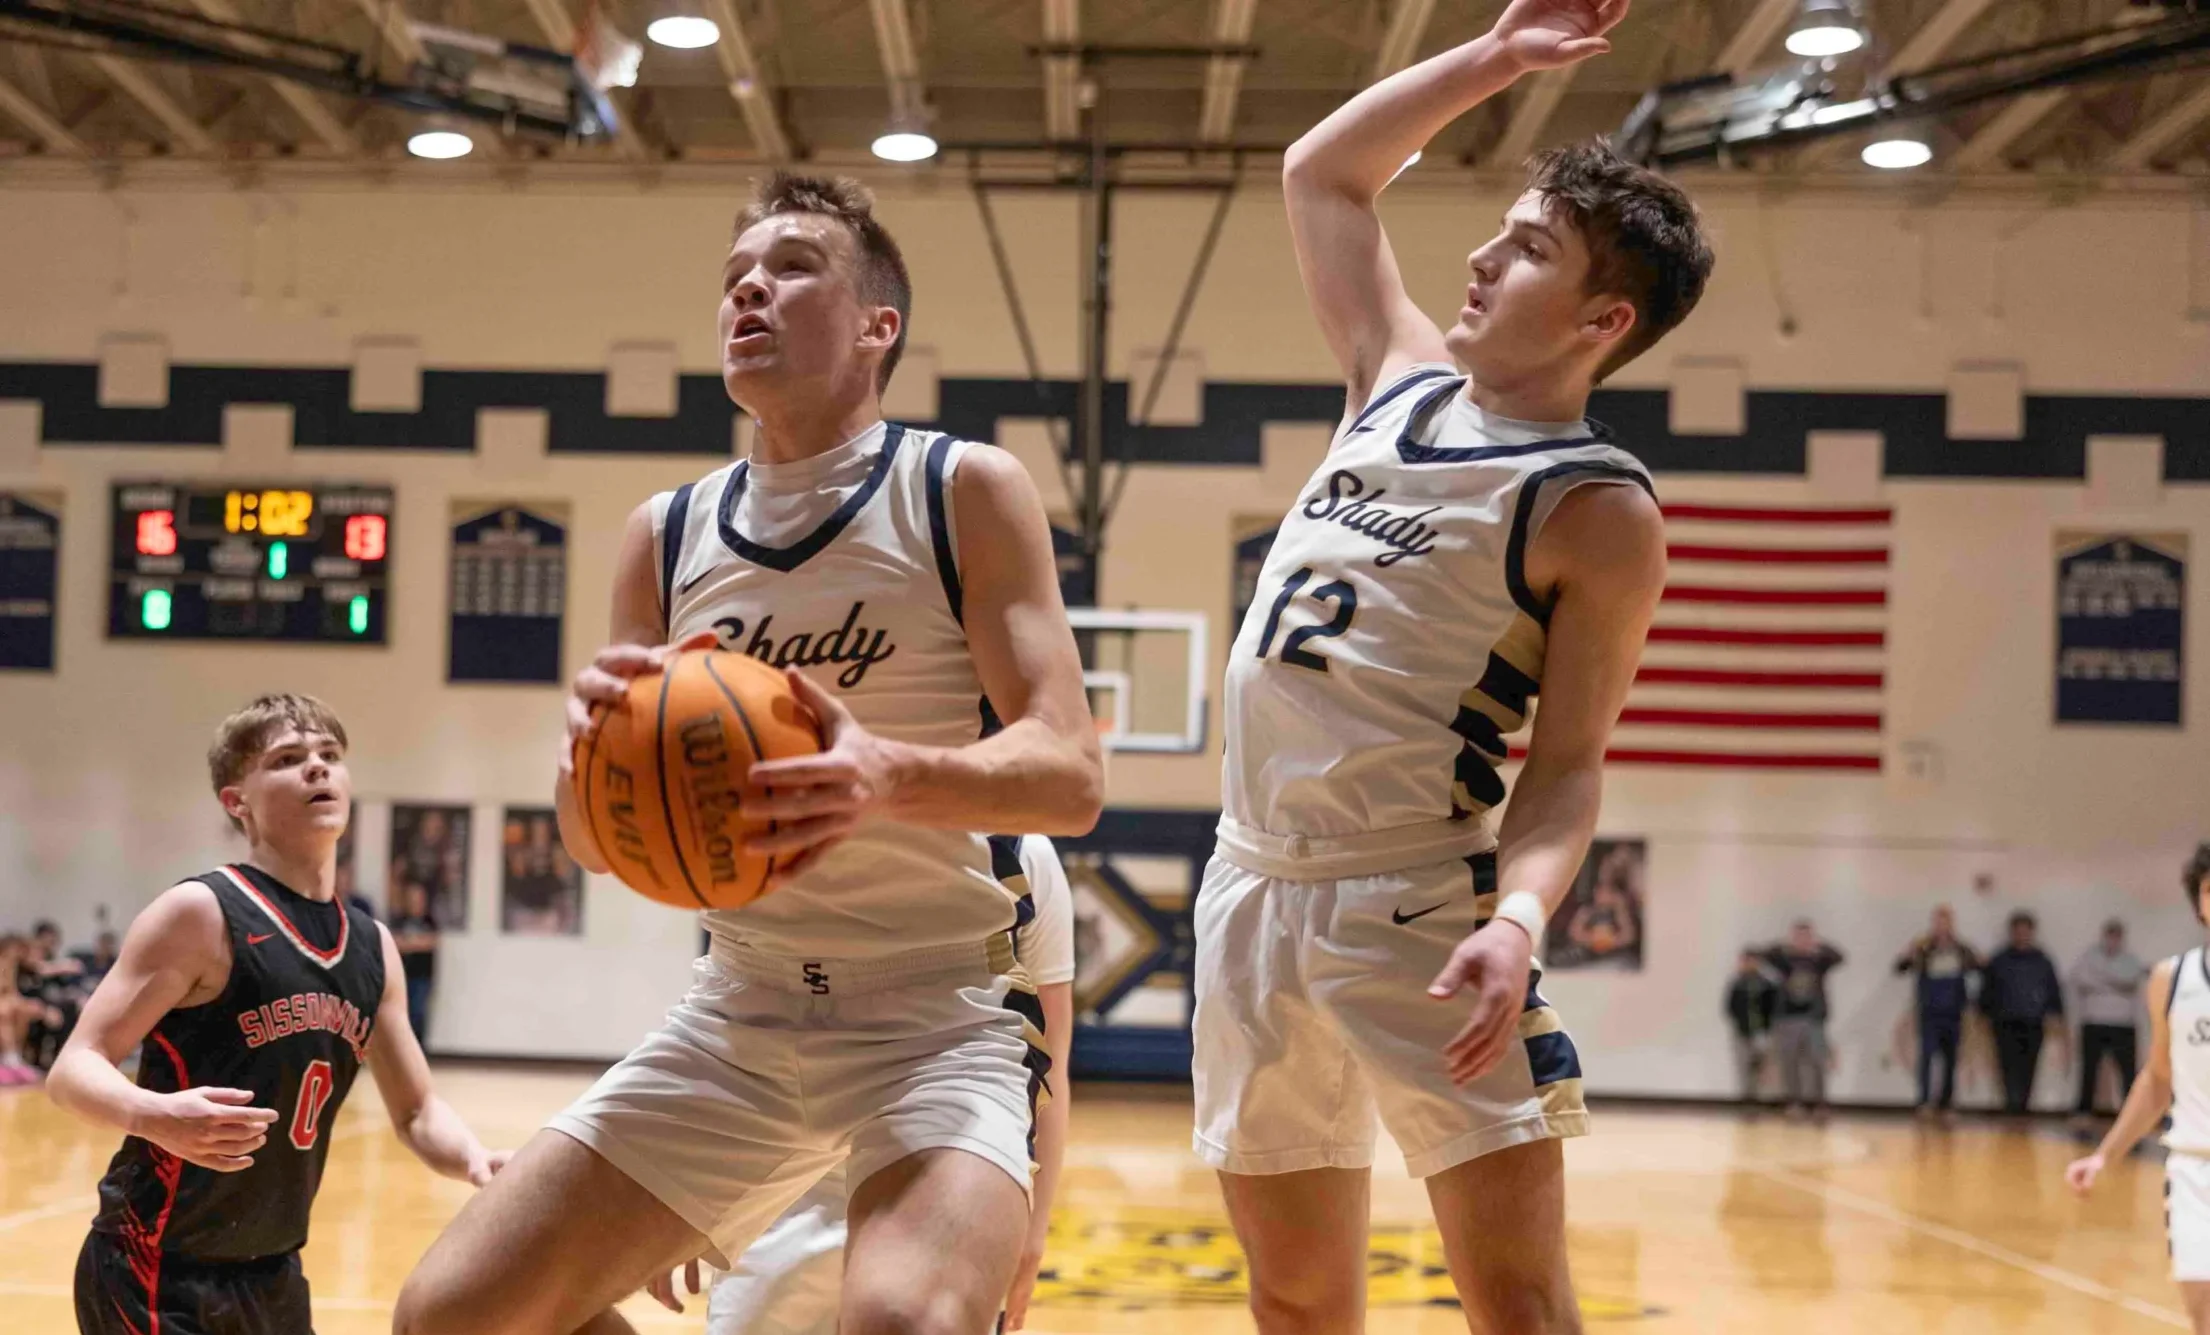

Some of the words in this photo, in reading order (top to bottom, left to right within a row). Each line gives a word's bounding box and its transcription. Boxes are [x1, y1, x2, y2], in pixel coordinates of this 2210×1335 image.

[225, 490, 312, 536] 1:02
[1303, 469, 1443, 568] Shady
[1256, 567, 1358, 672] 12
[288, 1059, 334, 1150] 0
